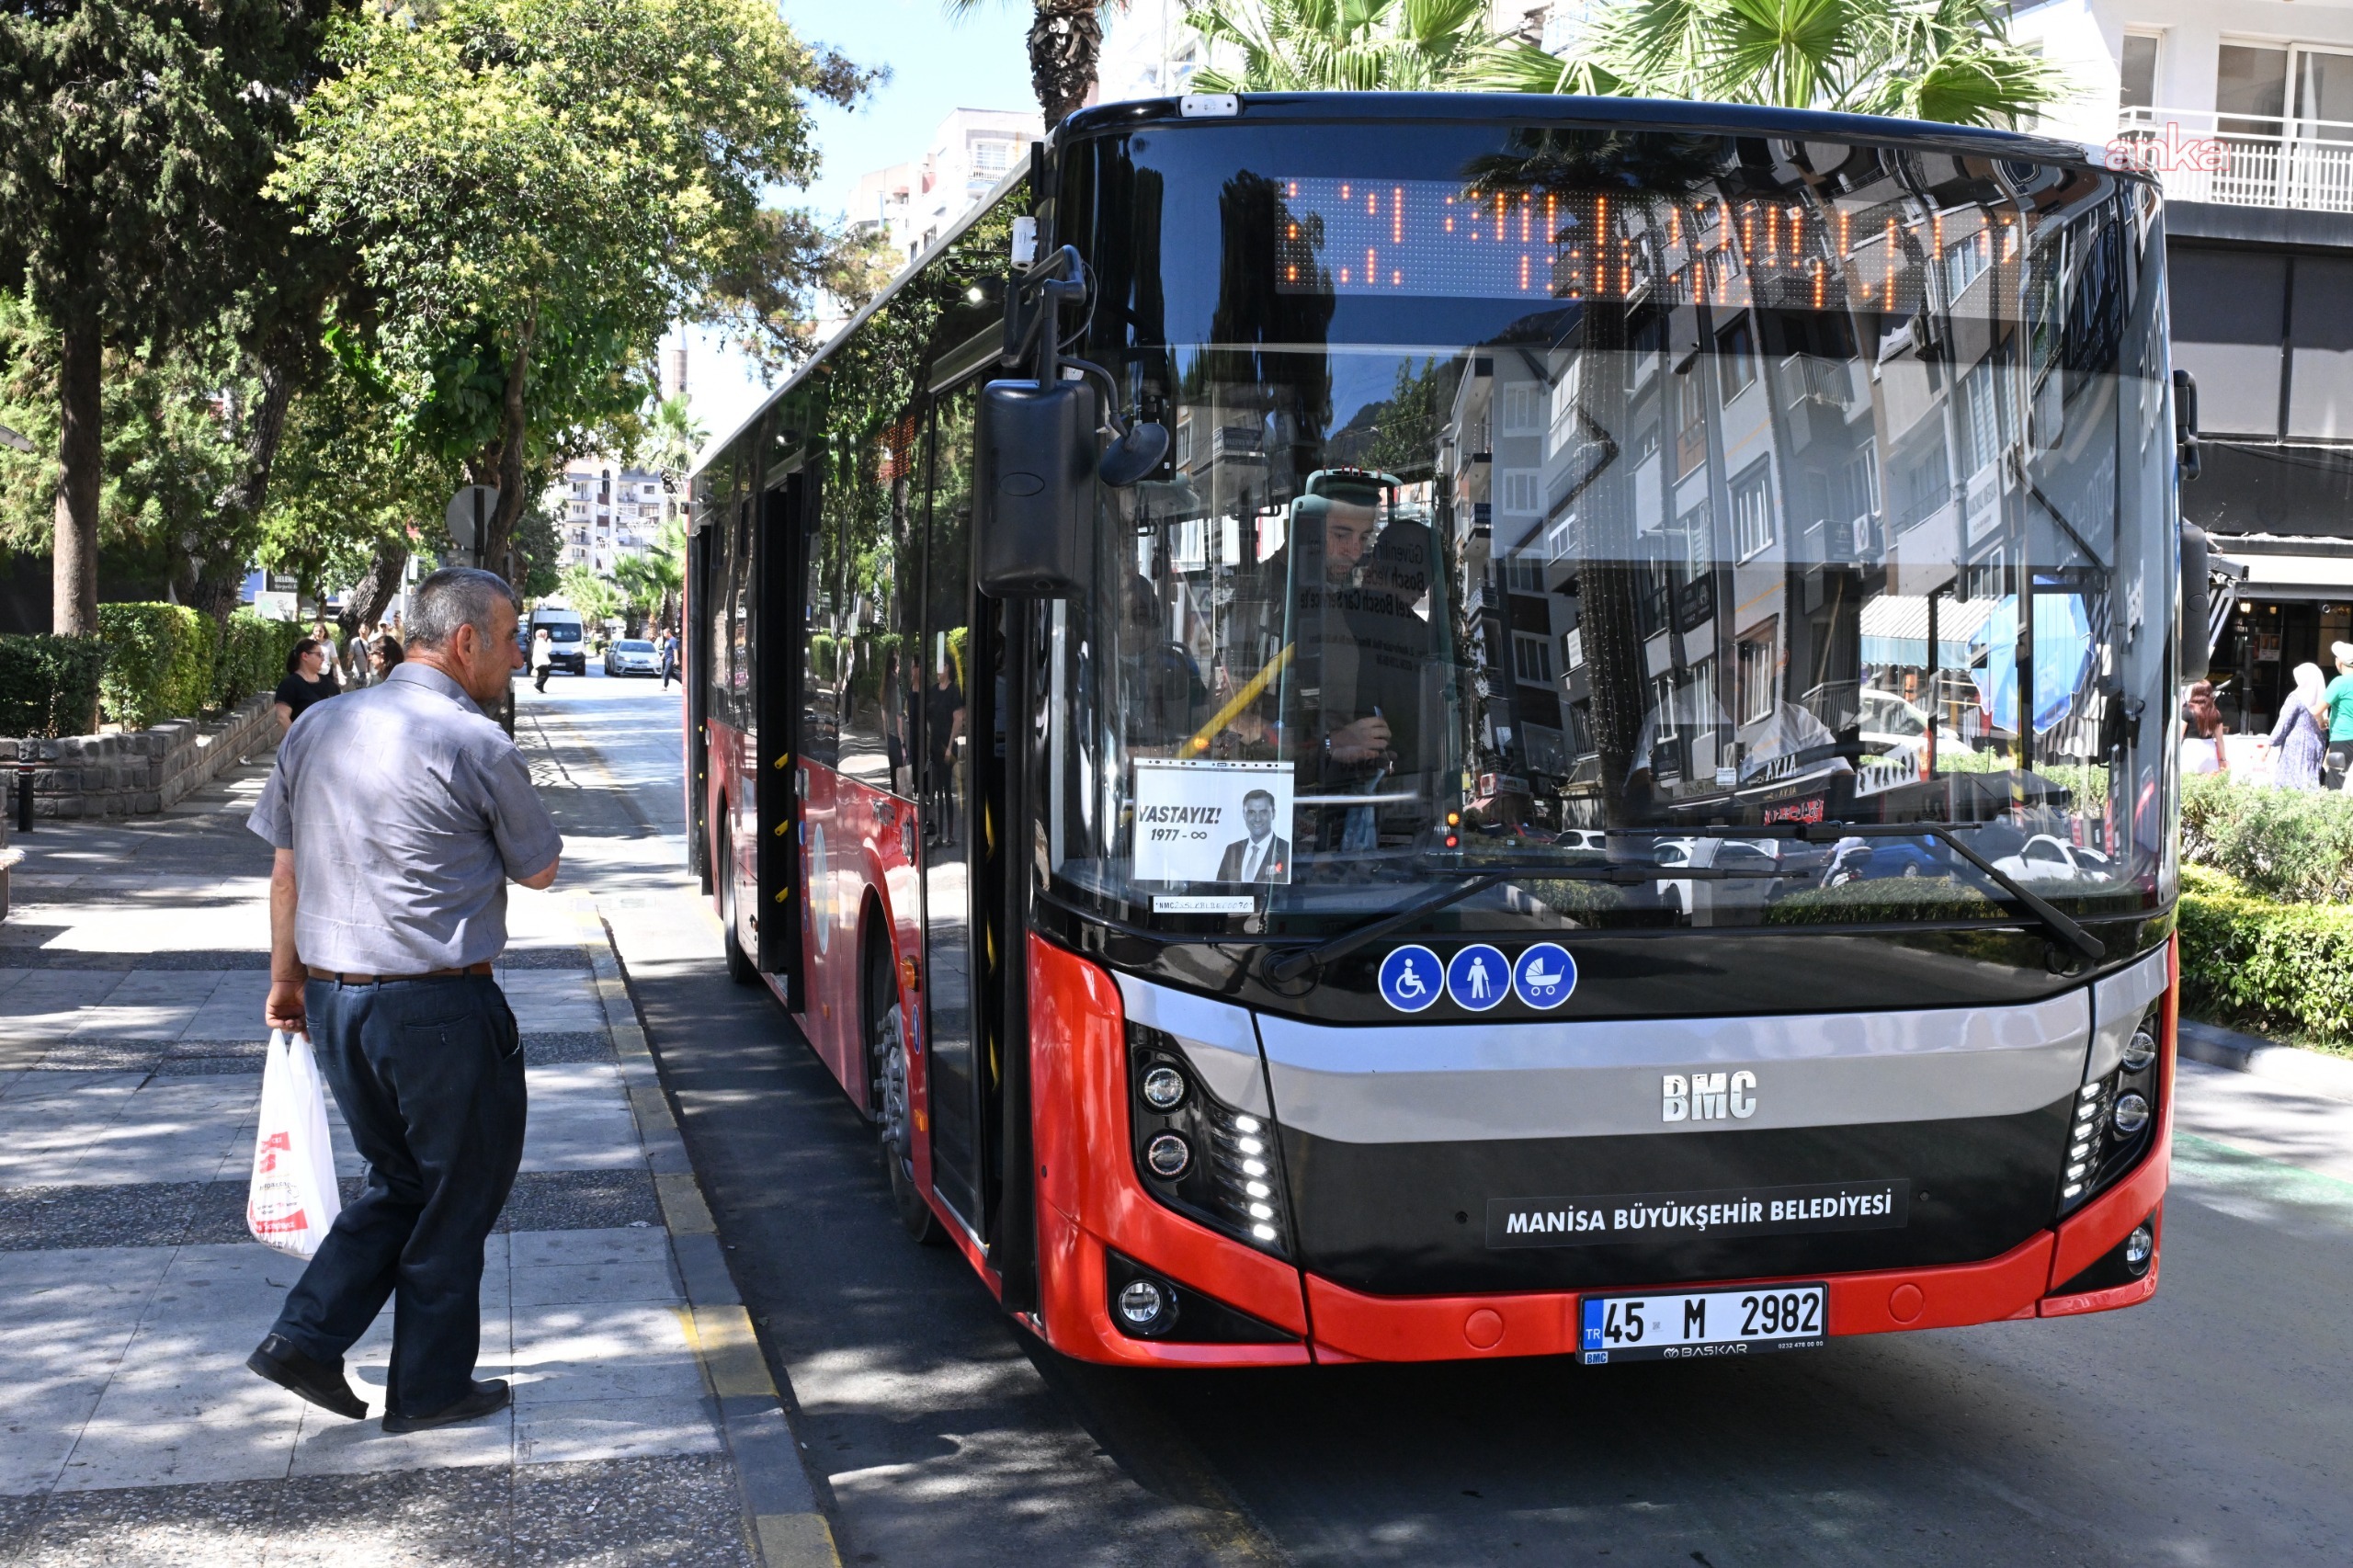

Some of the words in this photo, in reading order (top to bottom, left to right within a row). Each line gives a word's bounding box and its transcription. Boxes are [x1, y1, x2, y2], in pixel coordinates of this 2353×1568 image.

[1138, 805, 1222, 824] YASTAYIZ!
[1151, 828, 1180, 841] 1977
[1662, 1071, 1757, 1123] BMC
[1506, 1205, 1607, 1234] MANİSA
[1614, 1196, 1763, 1233] BÜYÜKŞEHİR
[1770, 1187, 1892, 1221] BELEDİYESİ
[1586, 1328, 1601, 1341] TR
[1604, 1301, 1645, 1344] 45
[1684, 1298, 1706, 1339] M
[1741, 1292, 1820, 1336] 2982
[1586, 1352, 1607, 1364] BMC
[1681, 1343, 1748, 1358] BASKAR
